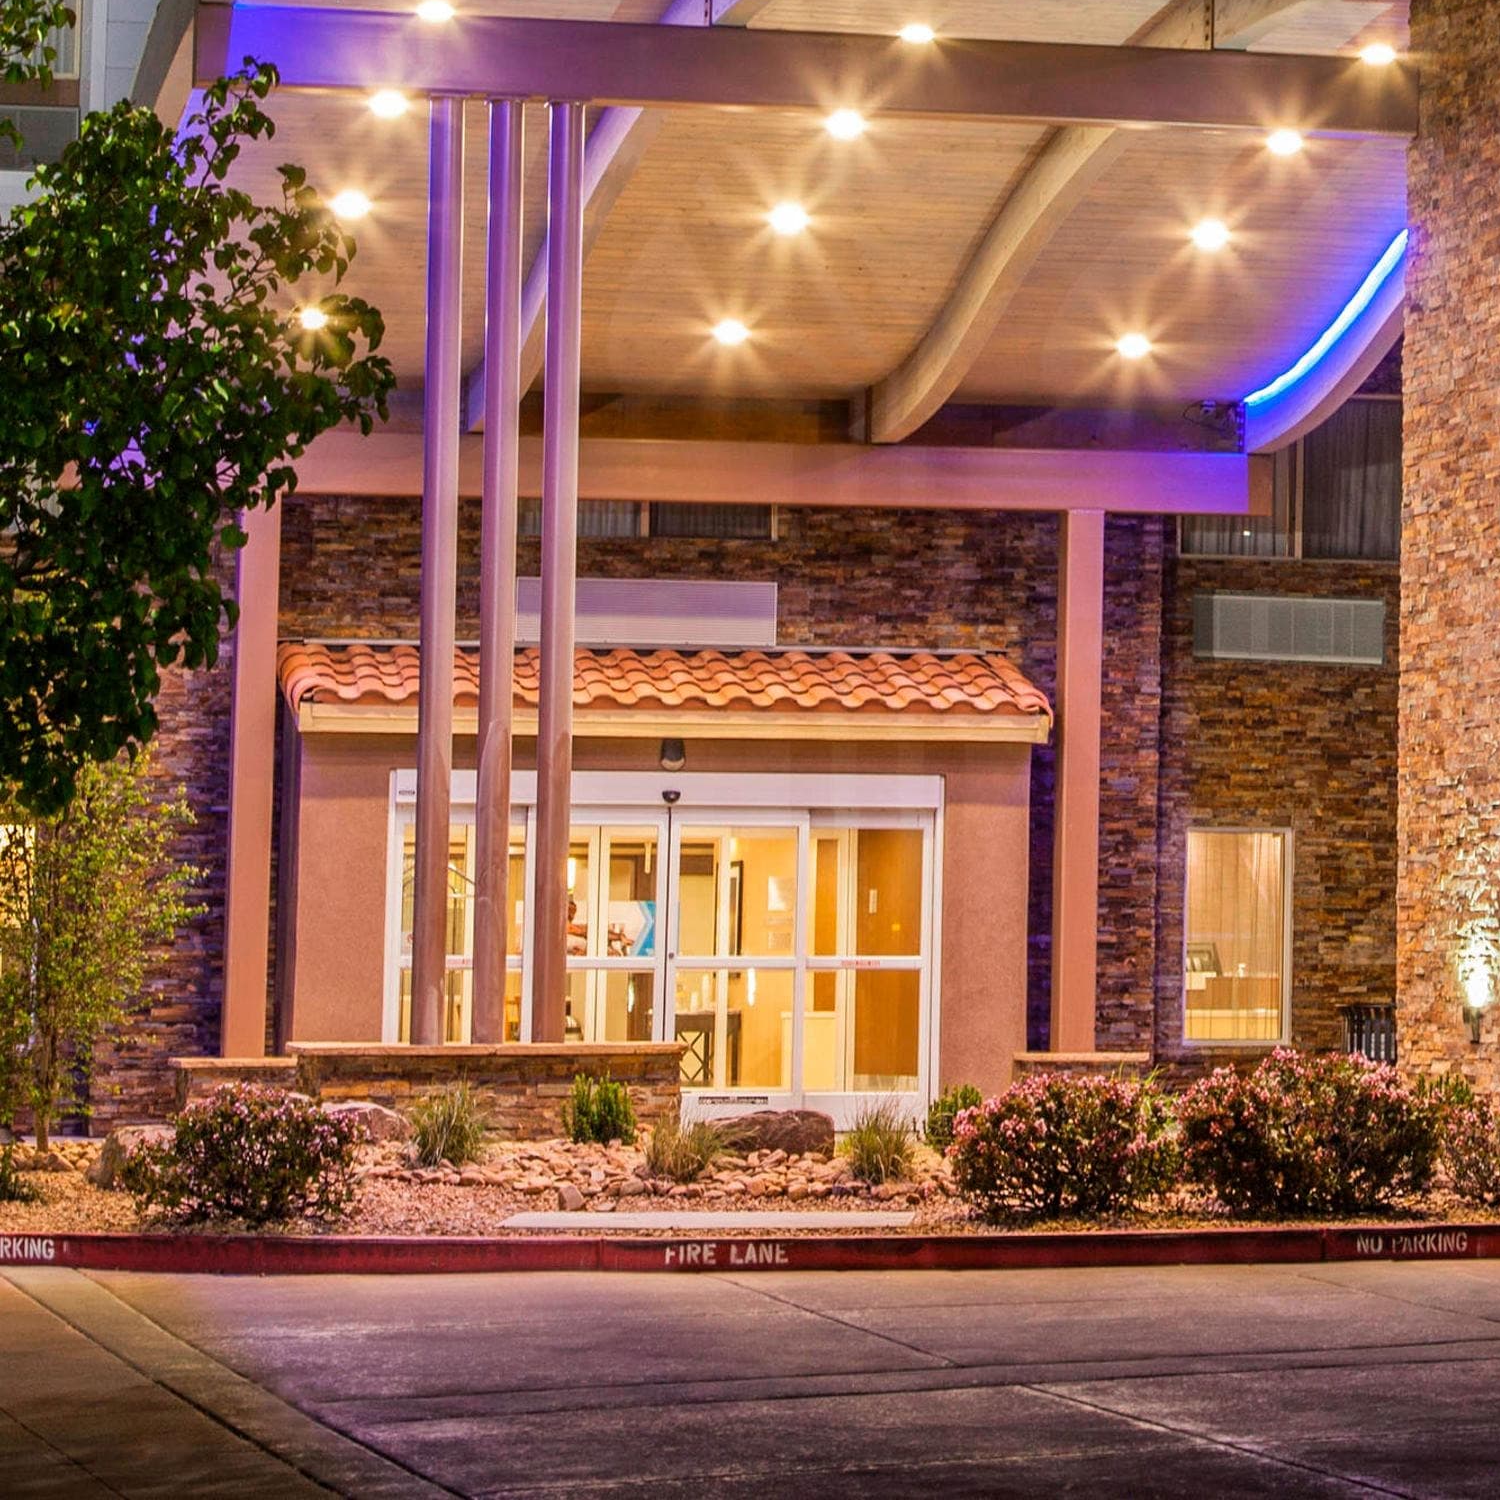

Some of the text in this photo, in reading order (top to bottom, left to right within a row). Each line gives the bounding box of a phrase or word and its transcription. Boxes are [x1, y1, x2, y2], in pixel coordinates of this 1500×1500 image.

[664, 1243, 789, 1265] FIRE LANE
[1356, 1232, 1468, 1254] NO PARKING
